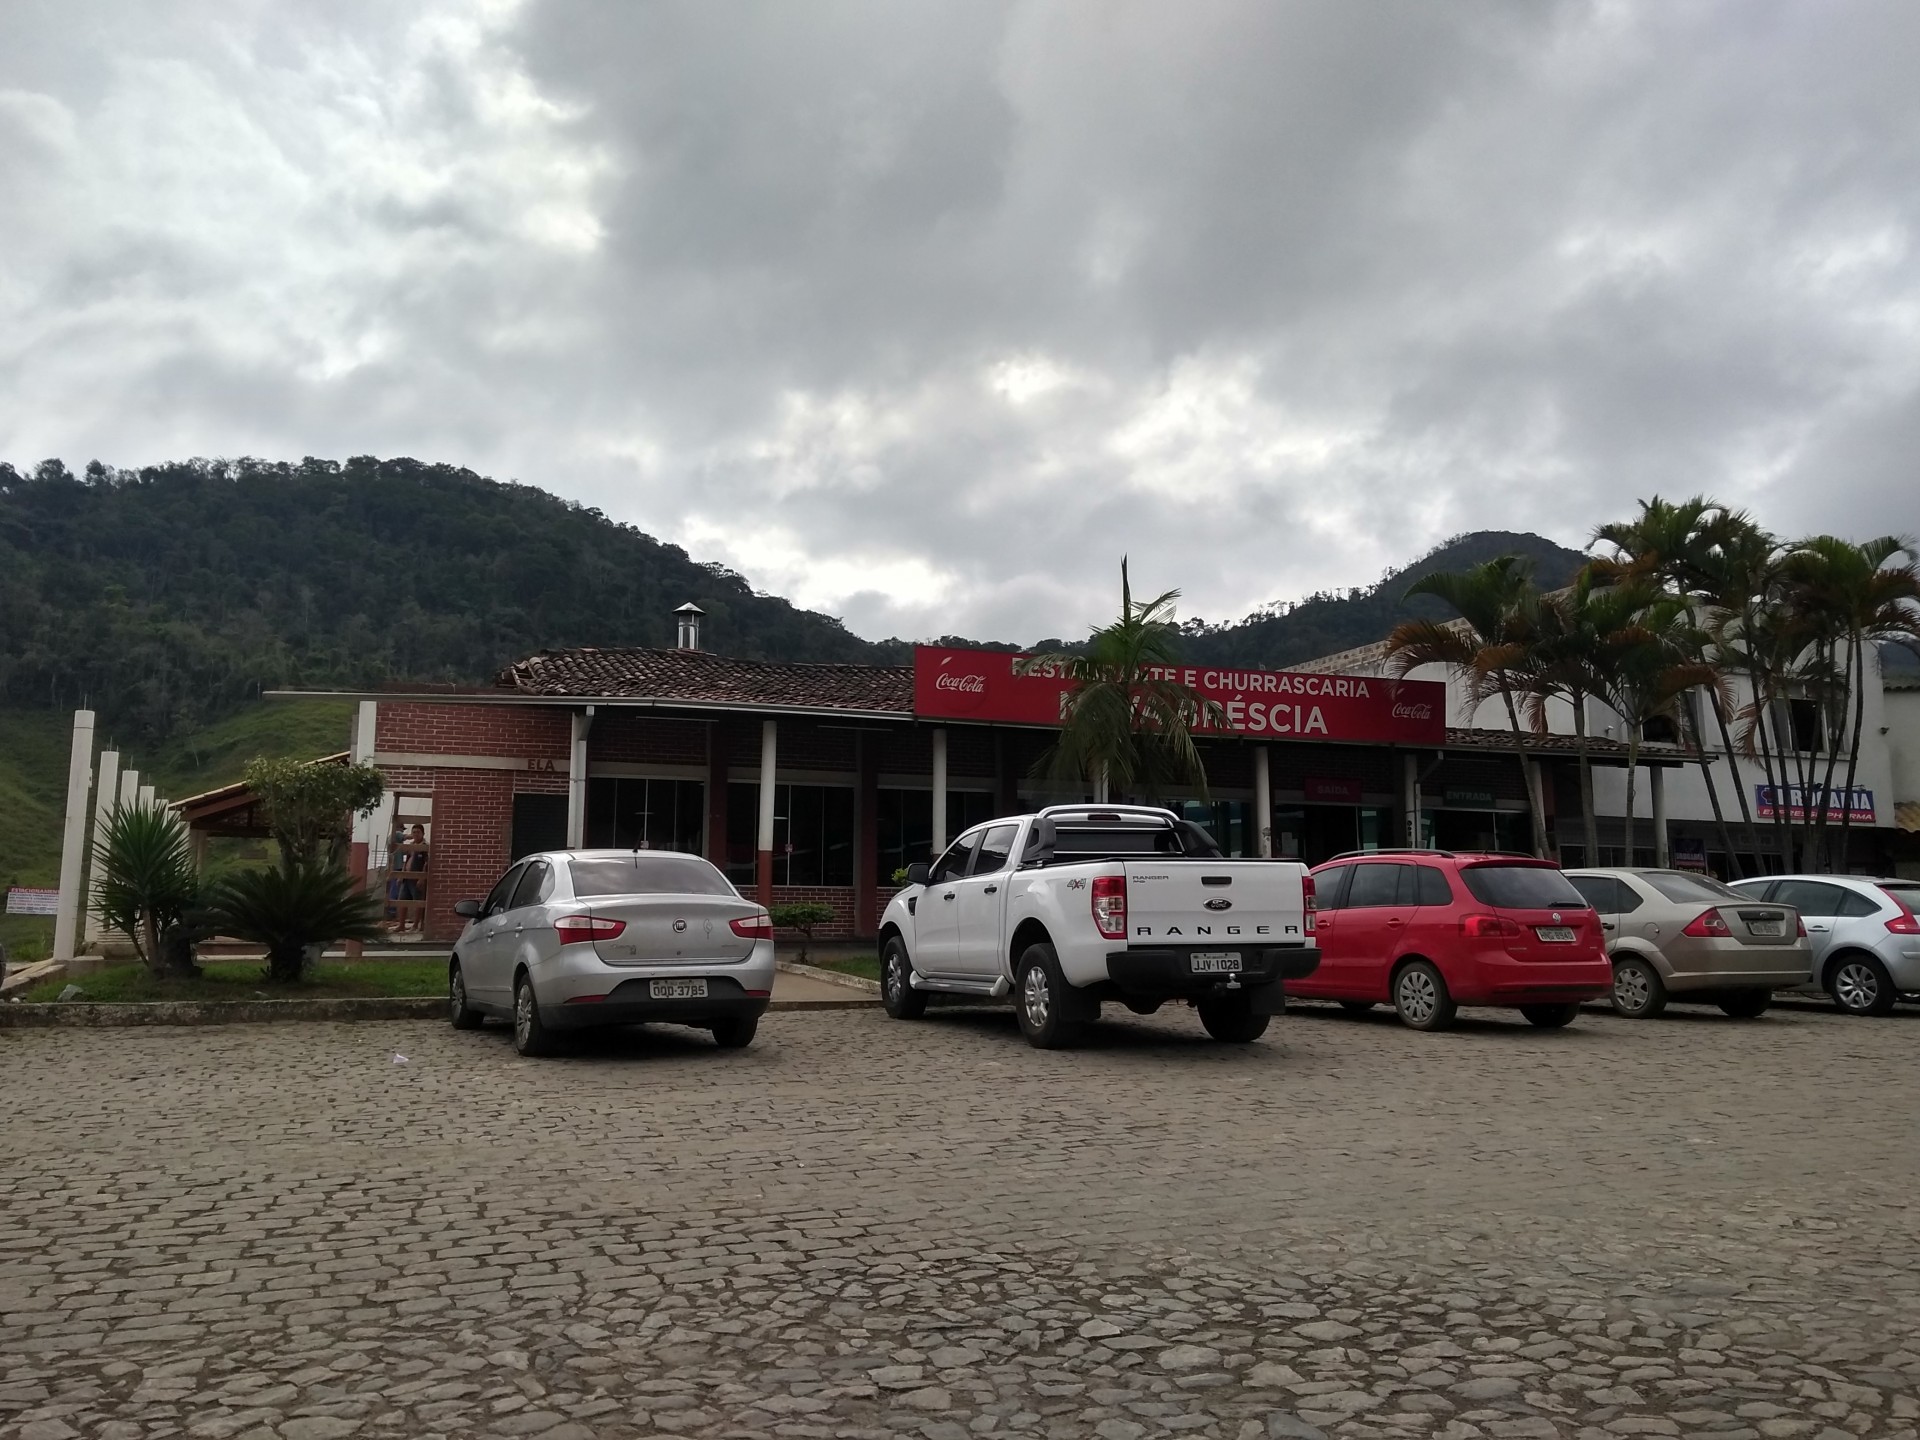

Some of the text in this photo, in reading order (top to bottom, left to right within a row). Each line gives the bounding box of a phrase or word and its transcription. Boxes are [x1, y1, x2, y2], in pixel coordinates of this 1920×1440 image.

[936, 673, 986, 692] Coca-Cola
[1184, 669, 1197, 688] E
[1203, 671, 1370, 698] CHURRASCARIA
[1392, 703, 1431, 719] Coca-Cola
[528, 759, 555, 771] ELA
[1317, 784, 1350, 795] SAÍDA
[1446, 791, 1492, 801] ENTRADA
[1826, 812, 1873, 820] PHRMA
[1137, 925, 1299, 936] RANGER
